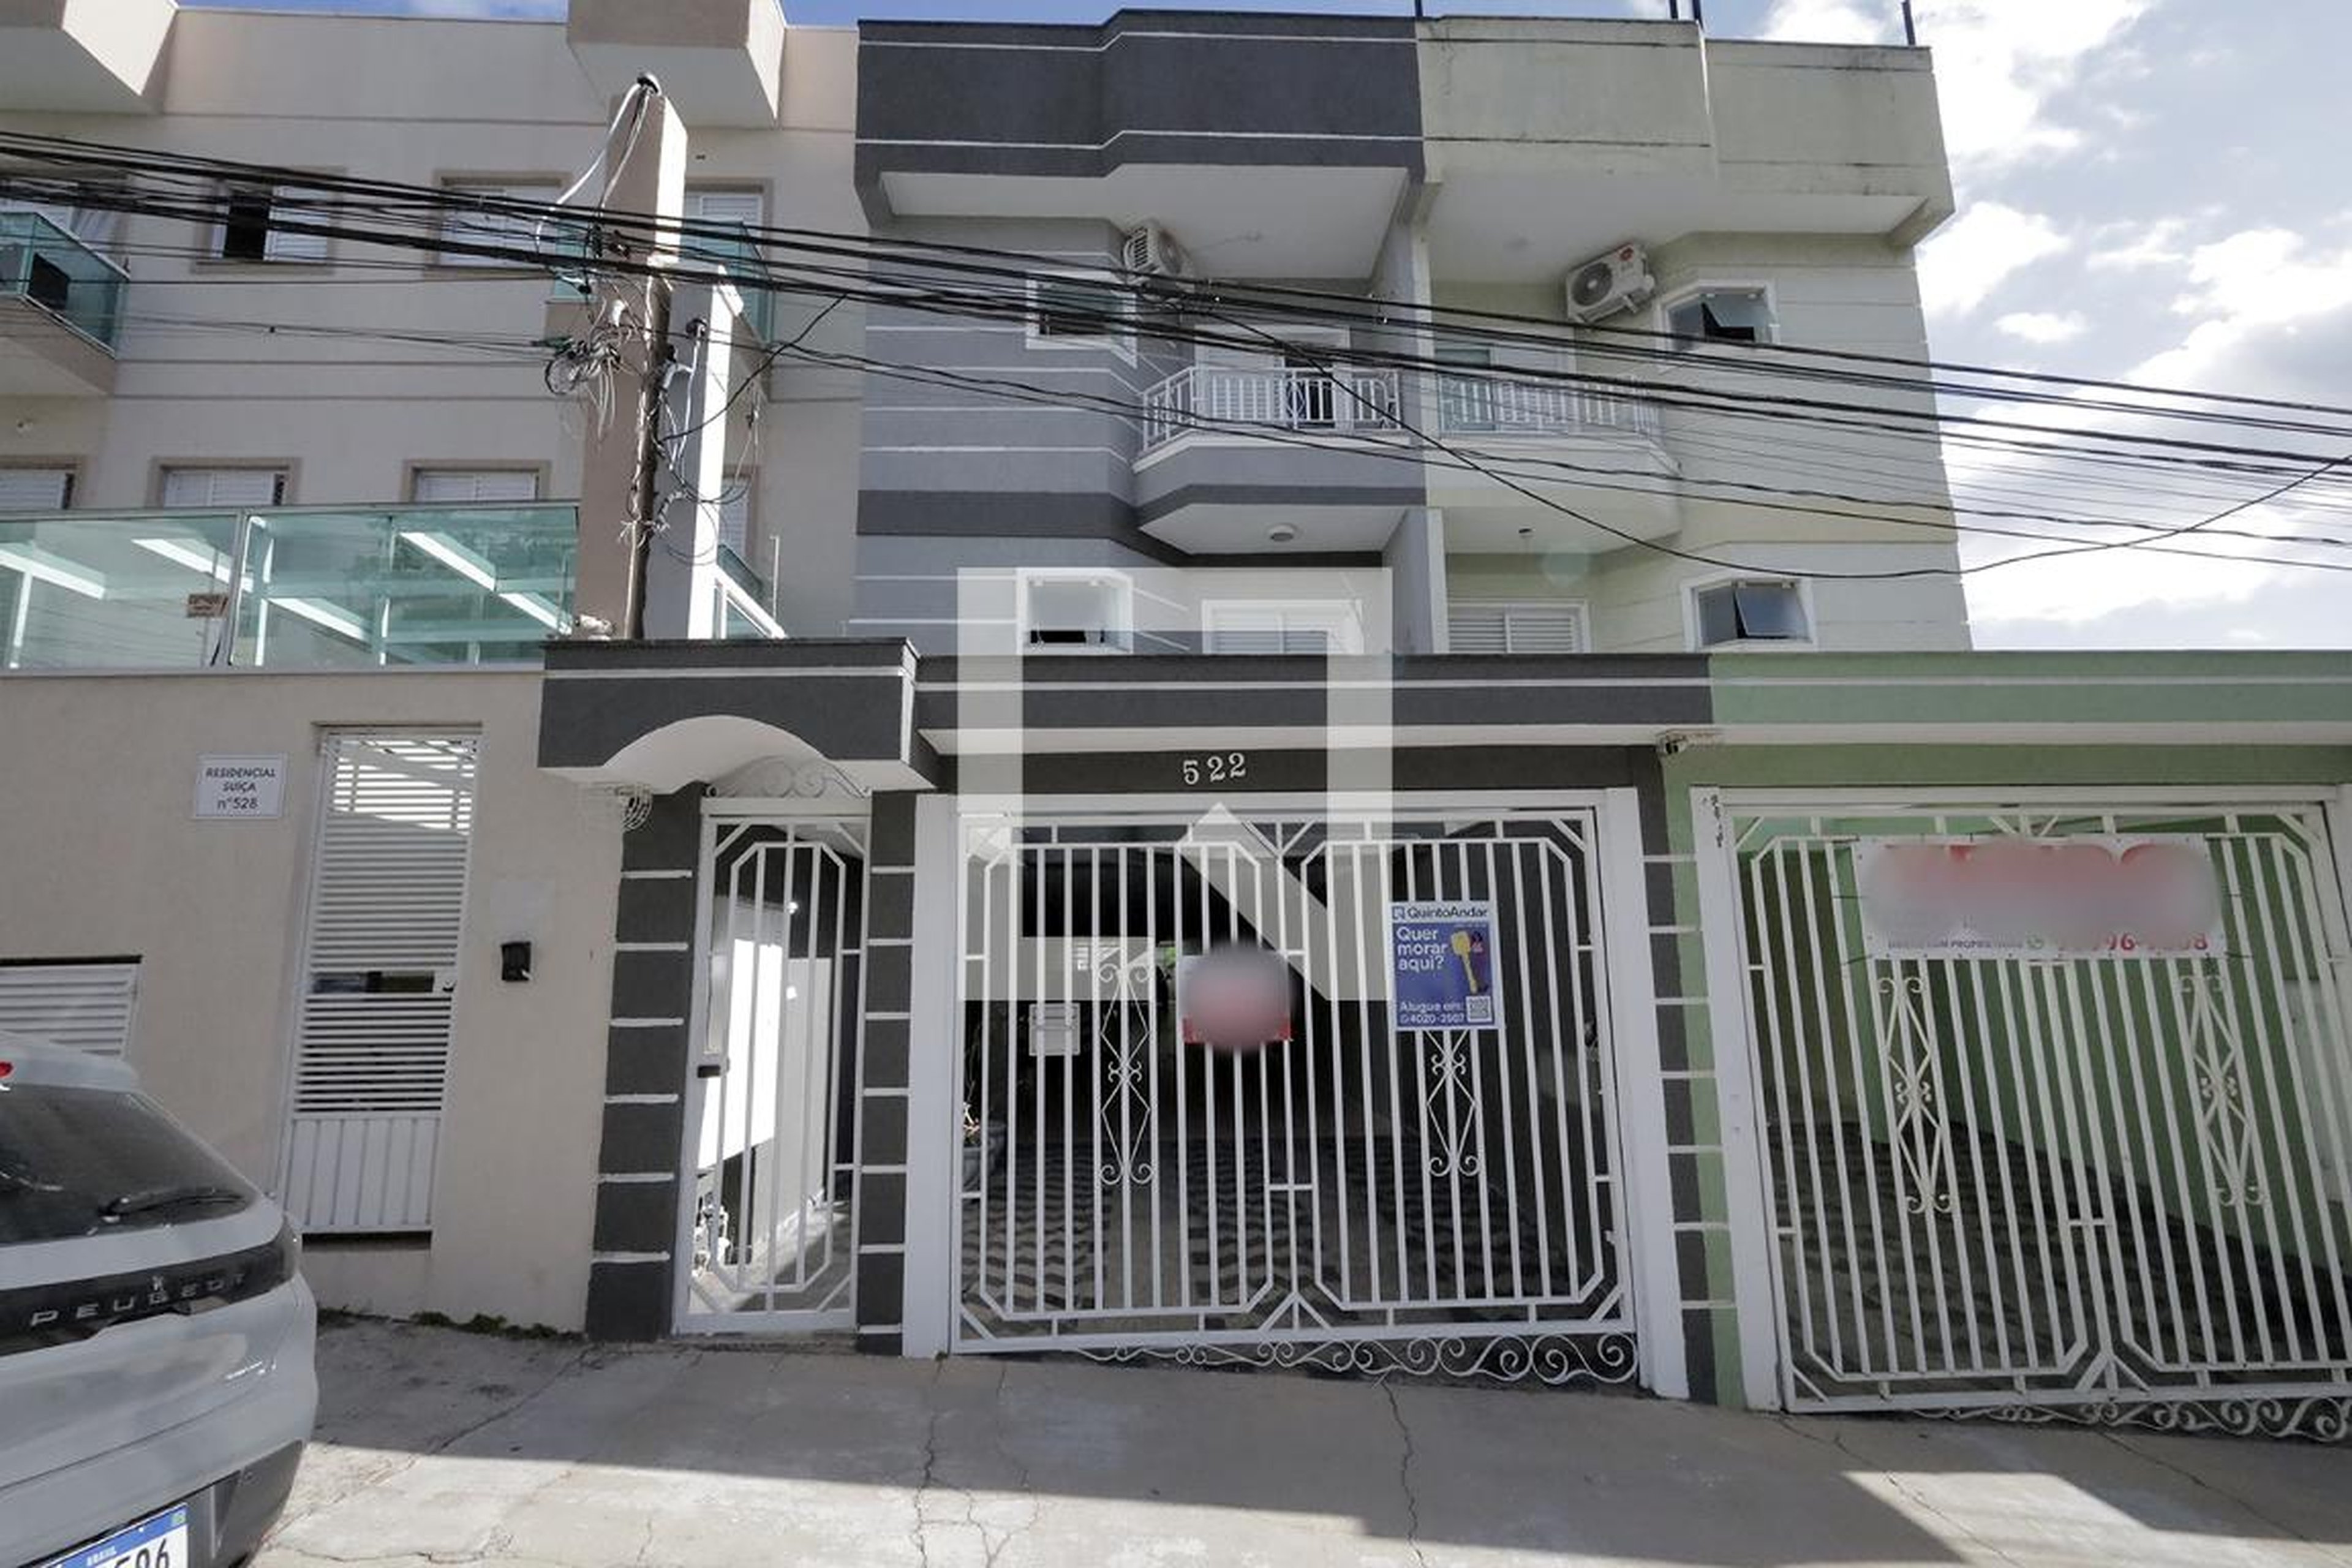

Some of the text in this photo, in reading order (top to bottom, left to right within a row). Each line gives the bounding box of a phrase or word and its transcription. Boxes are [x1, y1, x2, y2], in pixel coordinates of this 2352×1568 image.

[206, 767, 276, 777] RESIDENCIAL
[1183, 752, 1246, 785] 522
[1407, 906, 1488, 919] QuintoAndar
[1396, 927, 1438, 941] Quer
[1398, 943, 1448, 956] morar
[1398, 956, 1444, 973] aqui?
[1400, 1001, 1441, 1014] Alugue
[29, 1274, 244, 1327] PEUGEOT
